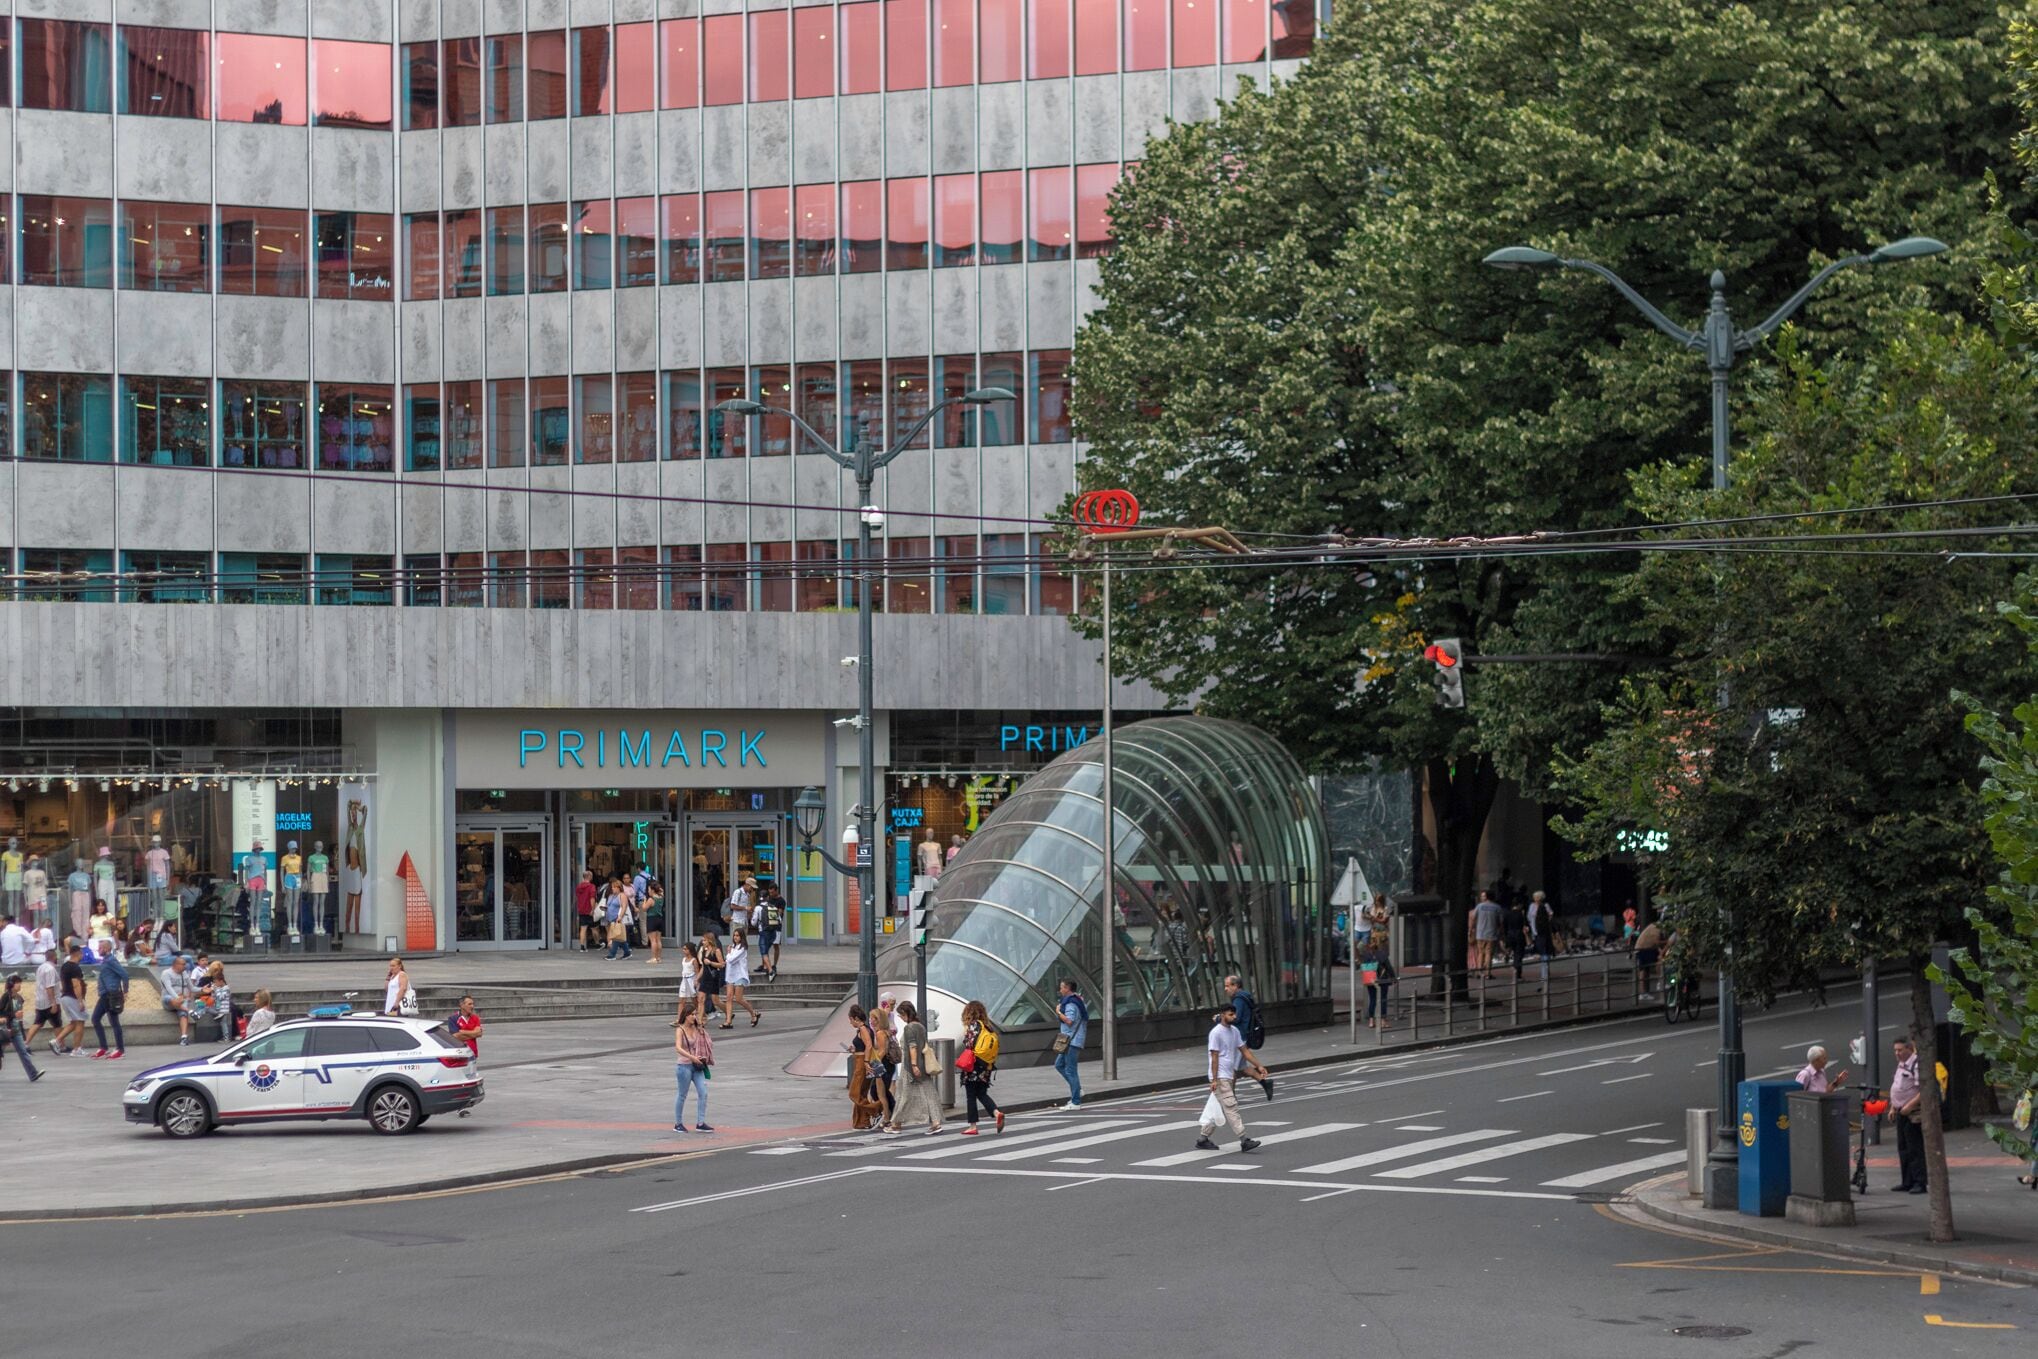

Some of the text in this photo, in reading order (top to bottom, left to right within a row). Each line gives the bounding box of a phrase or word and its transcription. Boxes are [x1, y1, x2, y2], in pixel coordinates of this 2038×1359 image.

[520, 729, 767, 768] PRIMARK
[892, 808, 923, 817] KUTXA
[895, 817, 920, 827] CAJA
